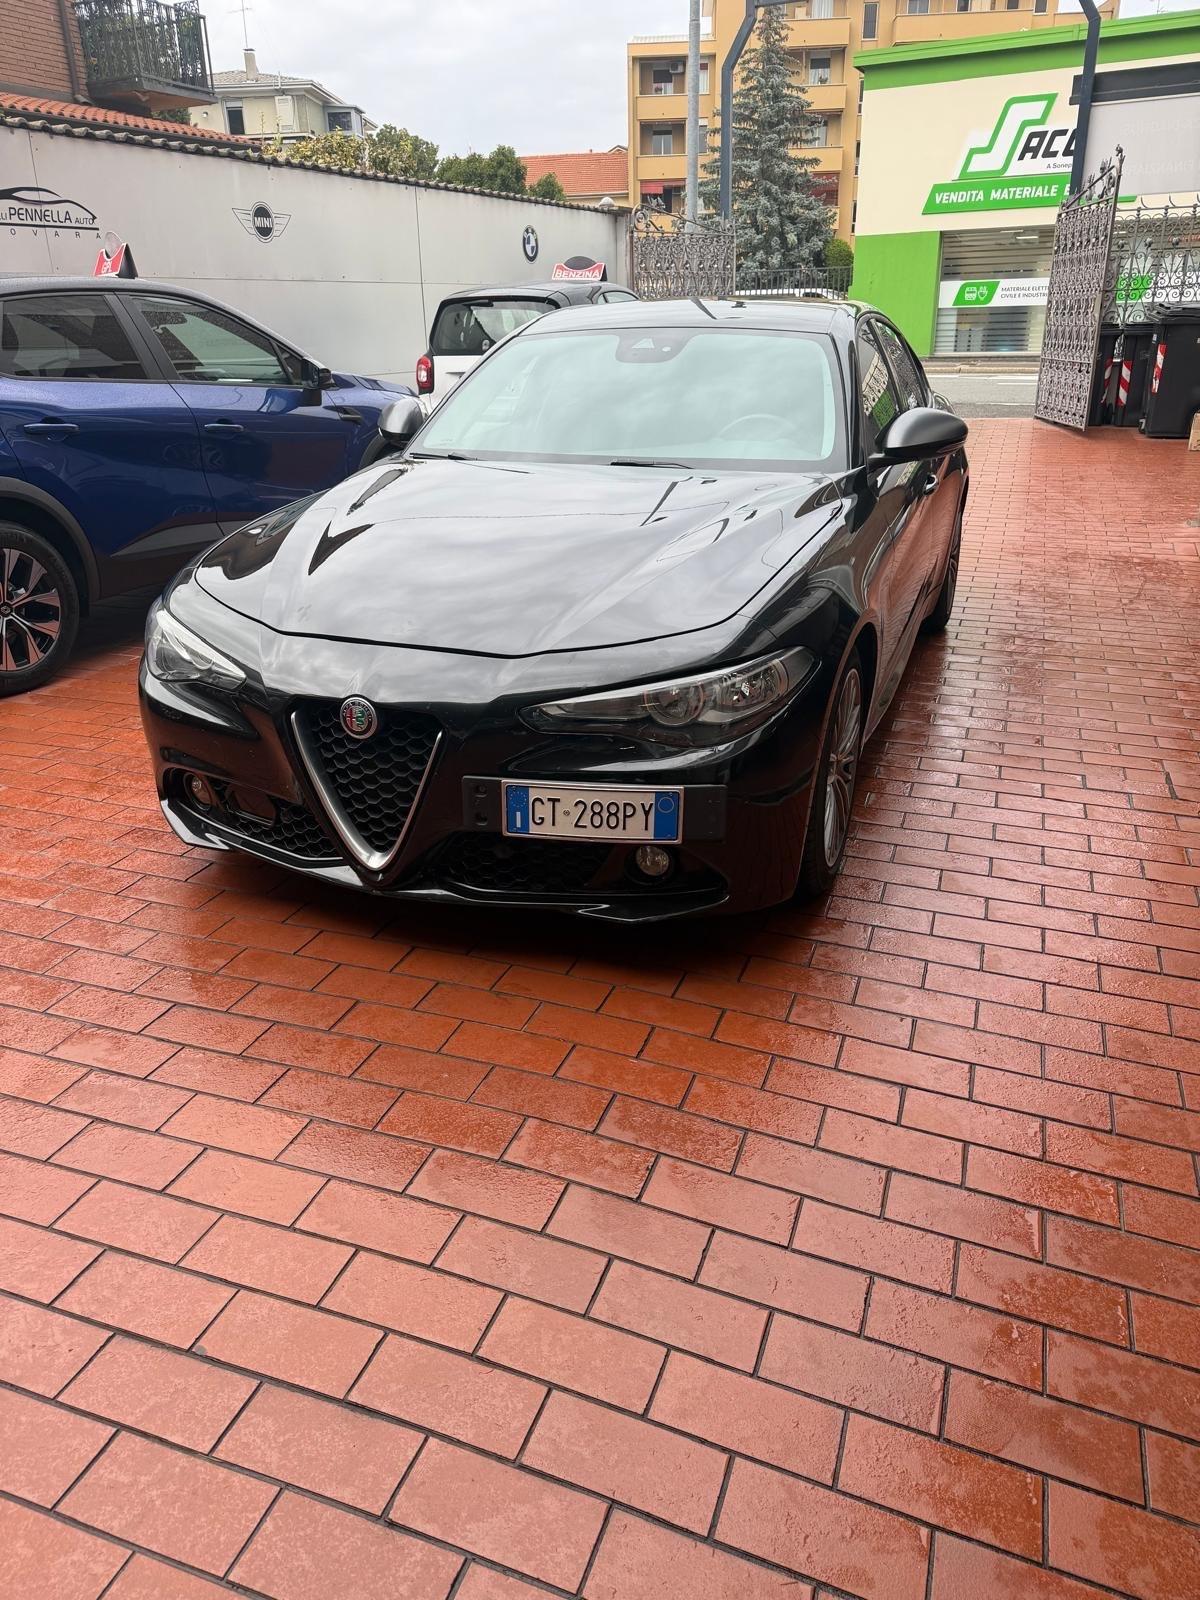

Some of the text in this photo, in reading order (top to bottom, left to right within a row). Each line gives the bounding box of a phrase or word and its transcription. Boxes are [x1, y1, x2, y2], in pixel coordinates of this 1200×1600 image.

[935, 190, 984, 204] VENDITA
[990, 184, 1058, 200] MATERIALE
[8, 207, 72, 224] PENNELLA
[74, 217, 95, 226] AUTO
[255, 216, 272, 228] MINI
[554, 269, 600, 278] BENZINA
[531, 797, 654, 831] GT 288PY
